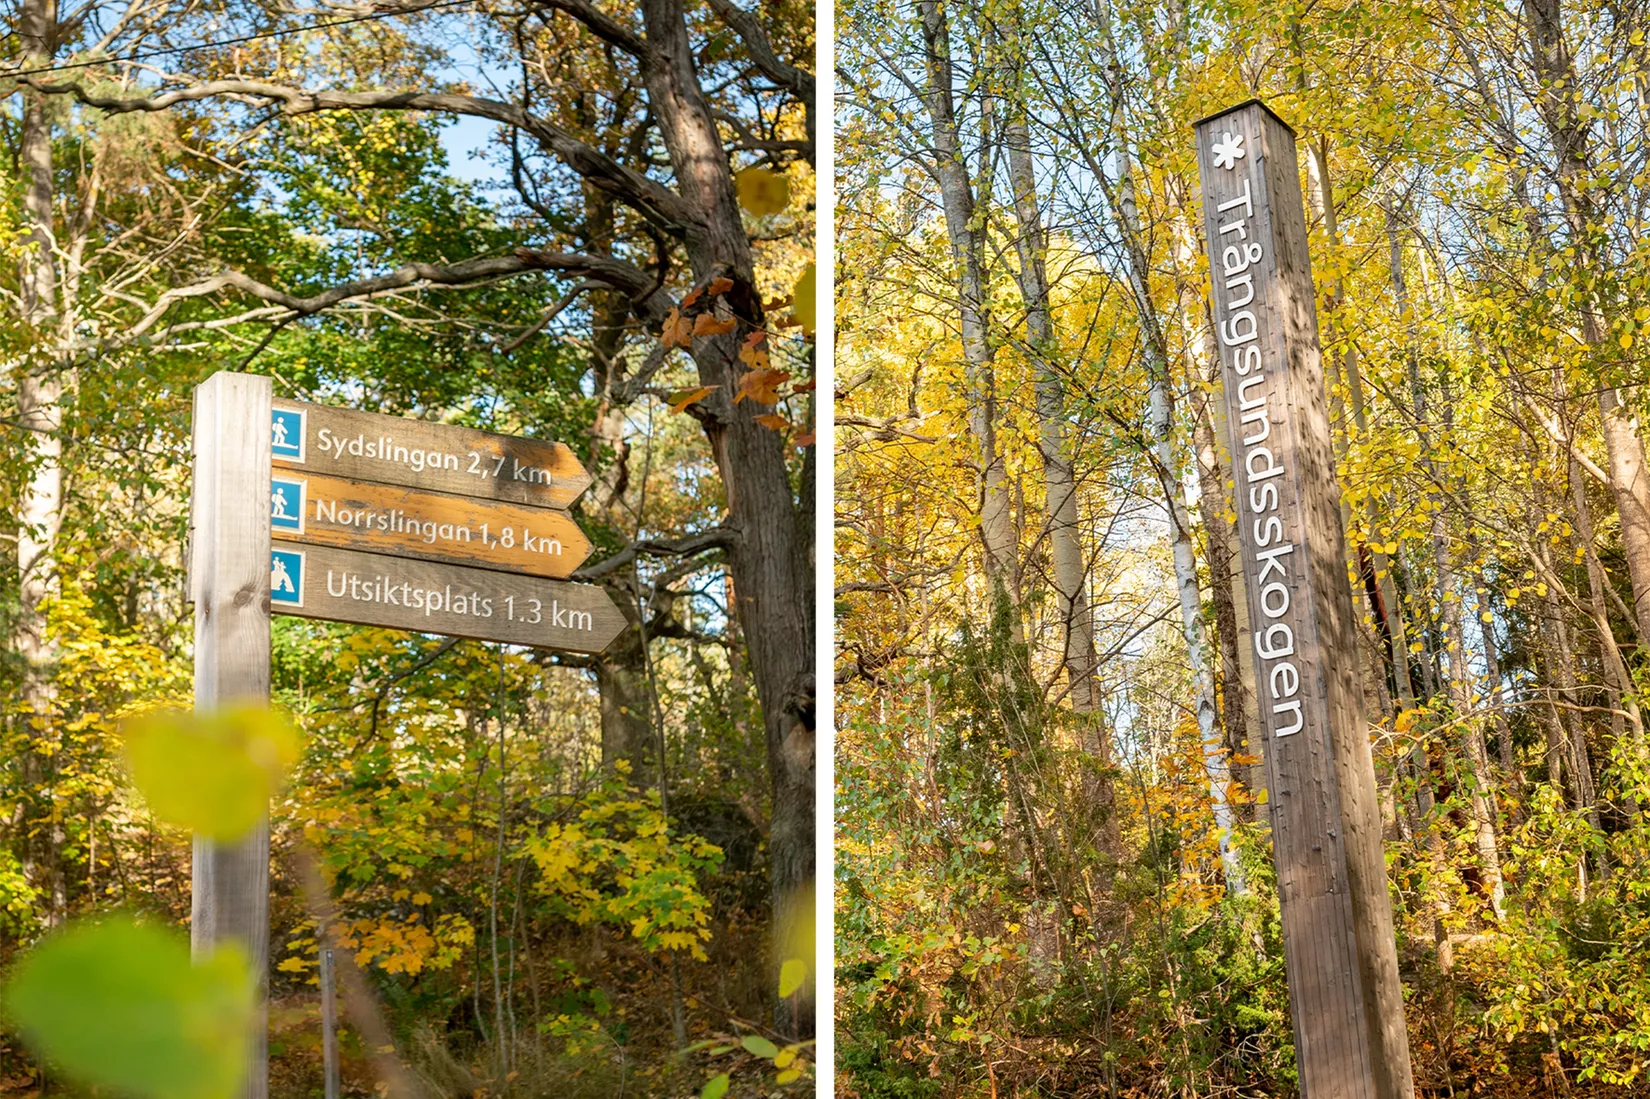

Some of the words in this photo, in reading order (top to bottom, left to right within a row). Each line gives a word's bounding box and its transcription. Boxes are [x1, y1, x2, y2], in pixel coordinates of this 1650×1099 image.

[317, 428, 459, 473] Sydslingan
[466, 452, 504, 479] 2,7
[513, 464, 552, 486] km
[1217, 179, 1305, 738] Trångsundsskogen
[316, 498, 471, 544] Norrslingan
[479, 523, 515, 550] 1,8
[523, 529, 562, 556] km
[326, 569, 493, 617] Utsiktsplats
[504, 595, 542, 625] 1.3
[551, 601, 593, 632] km
